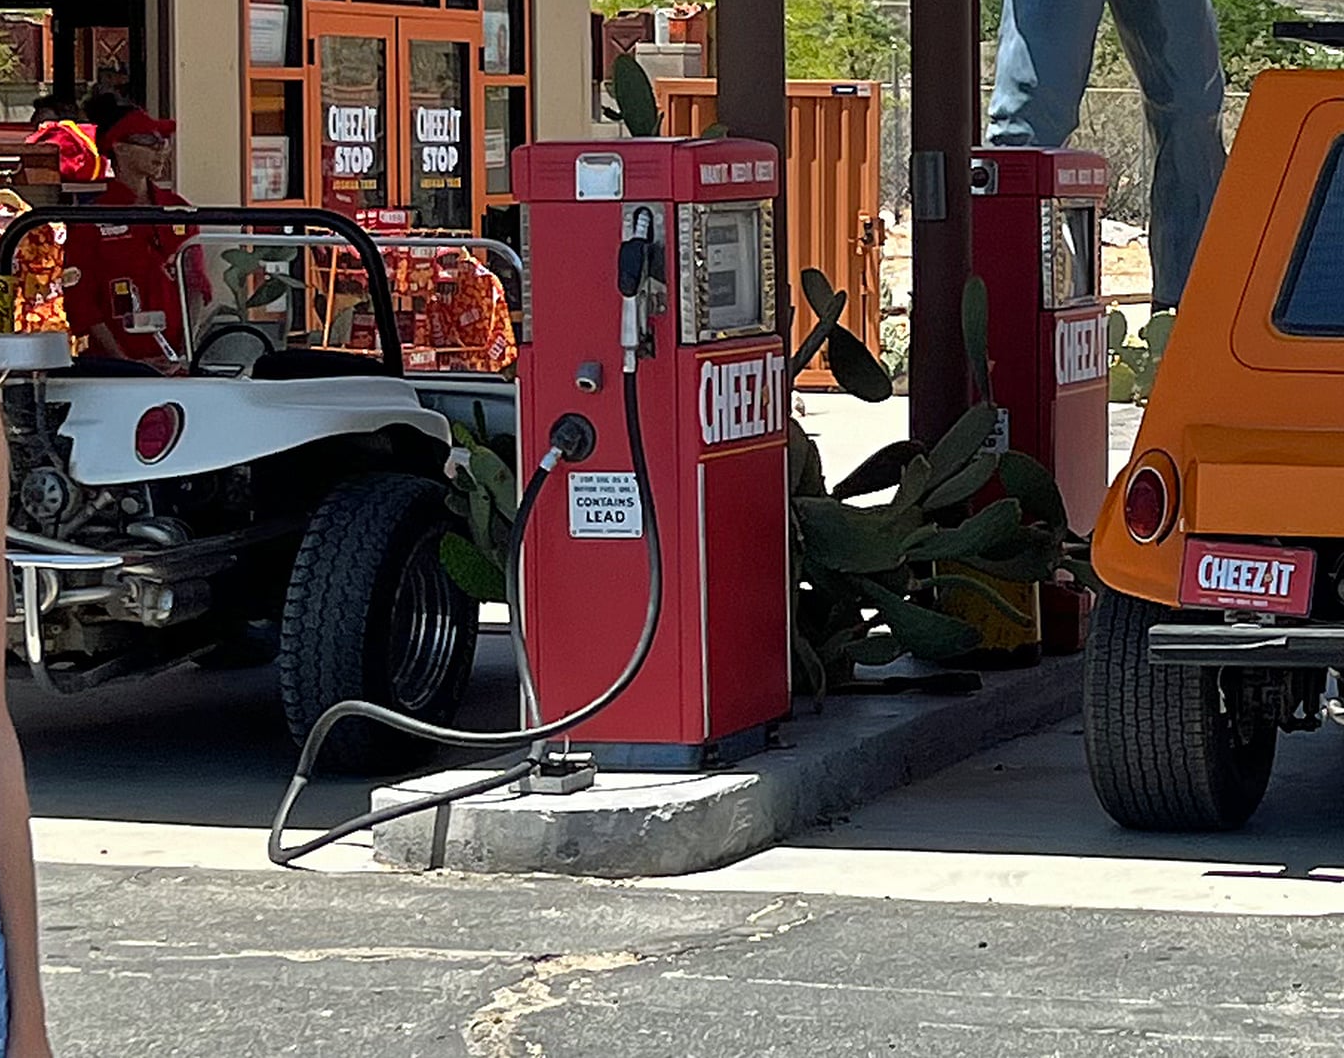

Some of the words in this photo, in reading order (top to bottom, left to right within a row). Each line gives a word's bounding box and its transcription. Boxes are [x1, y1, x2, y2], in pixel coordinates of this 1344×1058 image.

[334, 146, 374, 173] STOP
[422, 146, 458, 173] STOP
[576, 497, 635, 508] CONTAINS
[586, 510, 626, 523] LEAD
